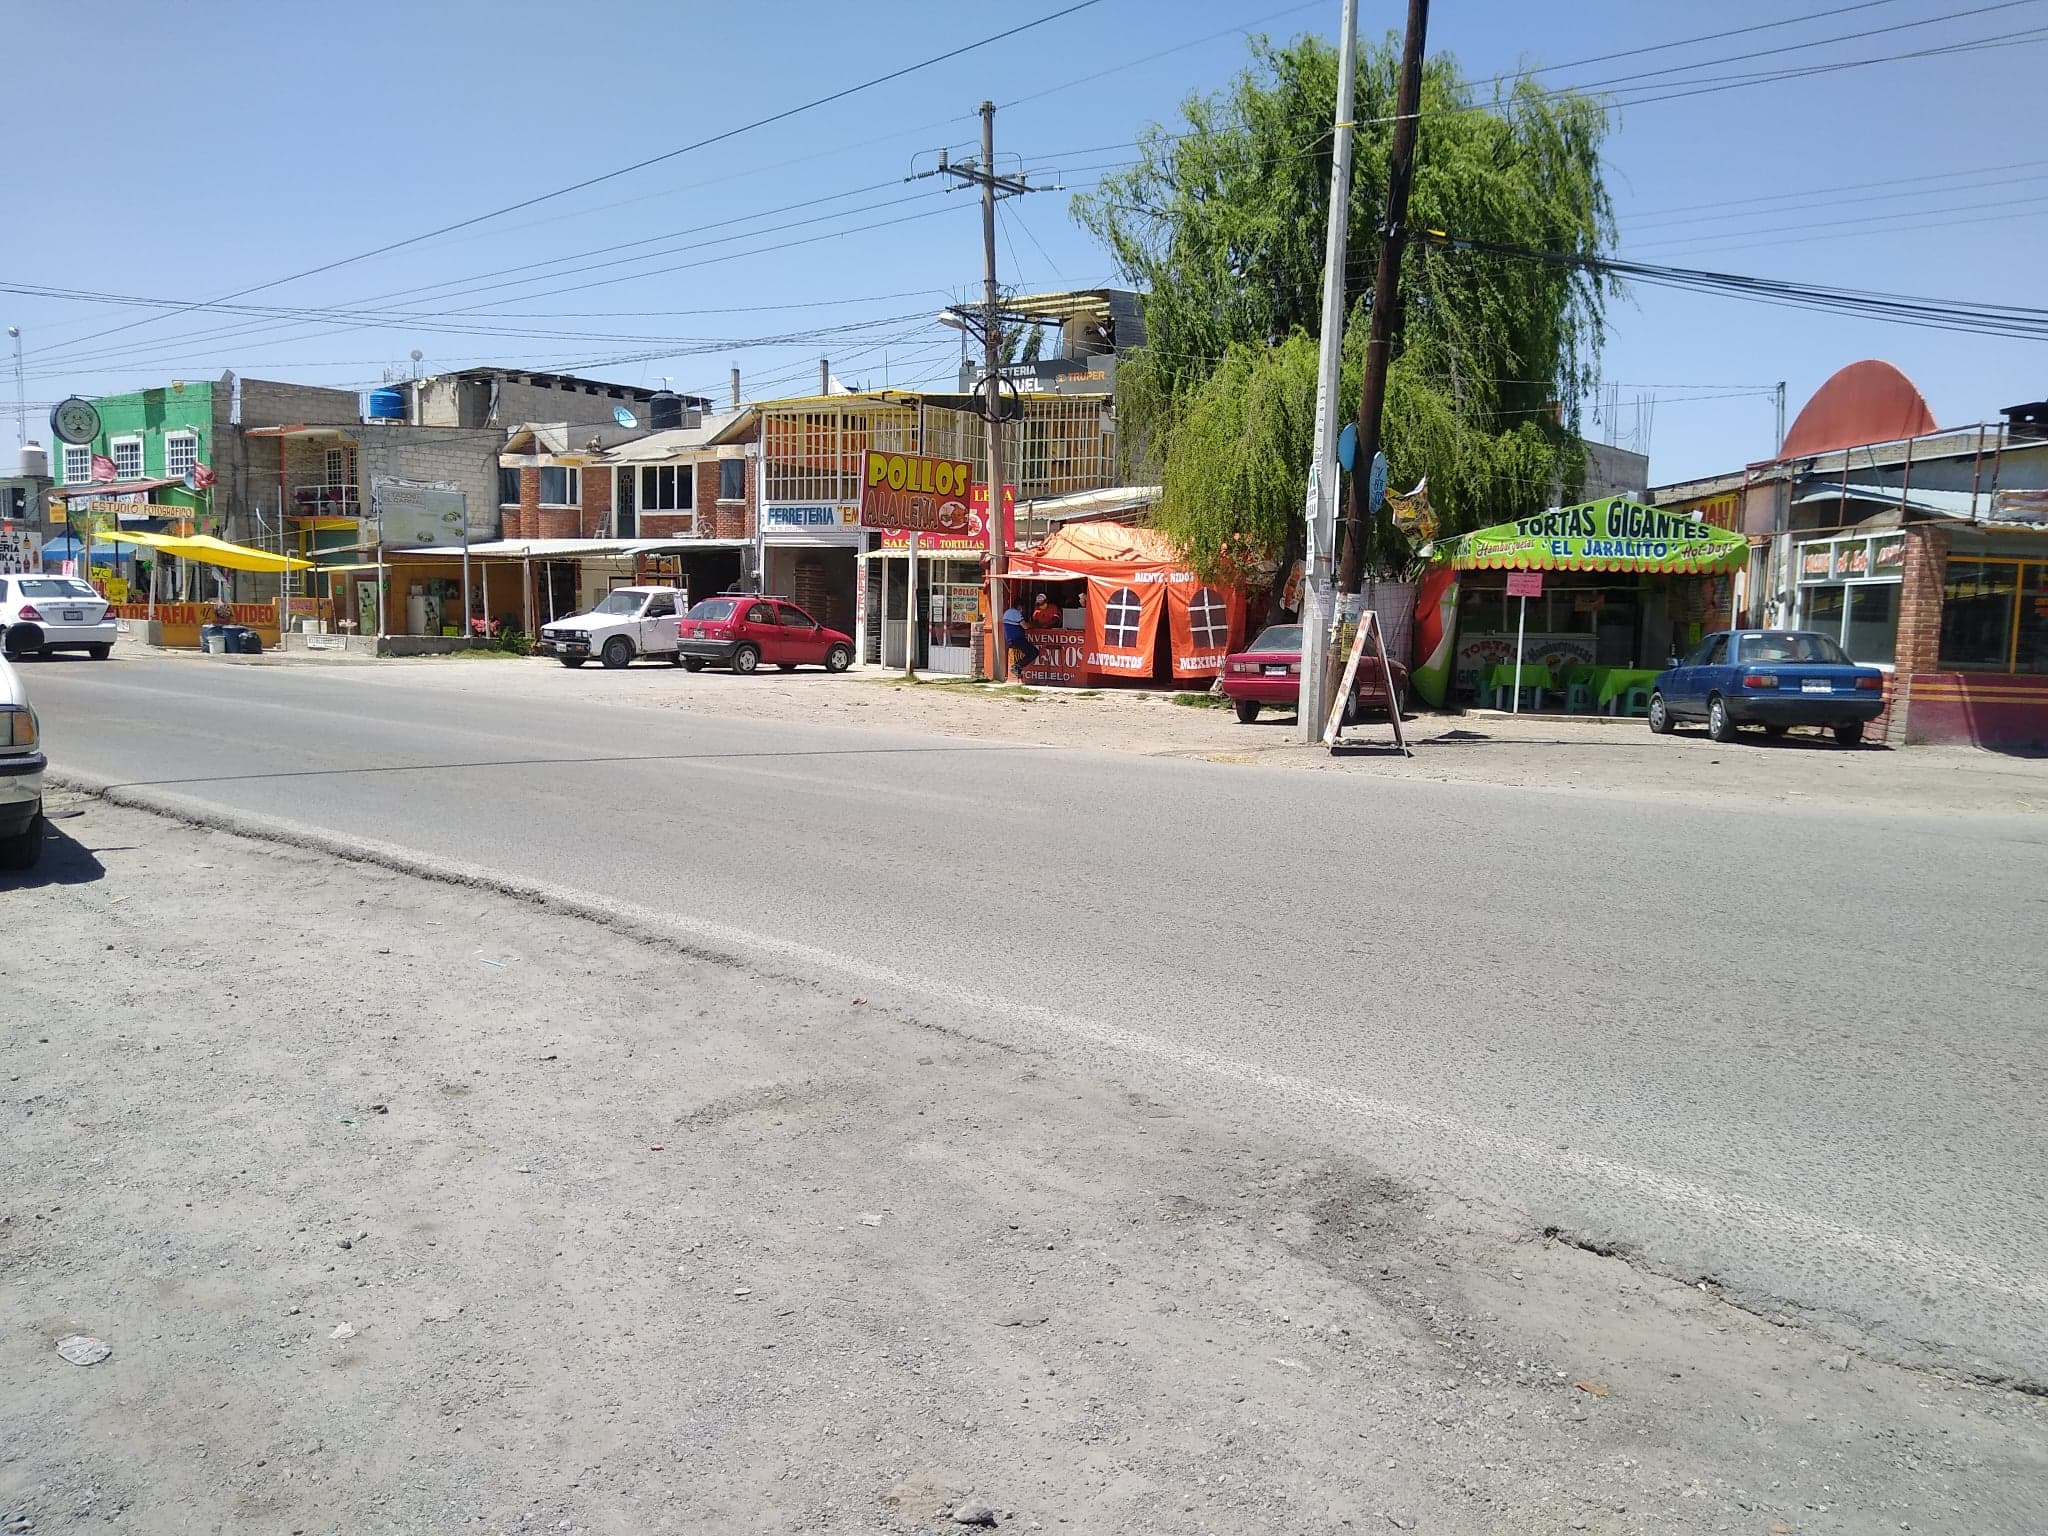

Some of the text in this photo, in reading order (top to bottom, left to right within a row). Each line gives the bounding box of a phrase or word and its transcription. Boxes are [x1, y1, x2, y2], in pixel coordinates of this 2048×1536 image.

[976, 364, 1036, 379] FEETERIA
[1068, 370, 1105, 382] TRUPER
[868, 452, 968, 498] POLLOS
[974, 489, 1014, 502] LEA
[91, 501, 139, 514] ESTUDIO
[864, 489, 878, 525] A
[878, 491, 900, 527] LA
[767, 506, 834, 526] FERRETERIA
[1515, 505, 1597, 538] TORTAS
[1607, 499, 1710, 540] GIGANTES
[883, 538, 928, 549] SALSS
[939, 539, 985, 549] TORTILLAS
[1475, 537, 1536, 558] Hamburguesas
[90, 567, 110, 579] WC
[233, 605, 273, 623] VIDEO
[1025, 633, 1085, 645] NVENIDOS
[1086, 652, 1226, 671] ANTOJITOS MEXICA
